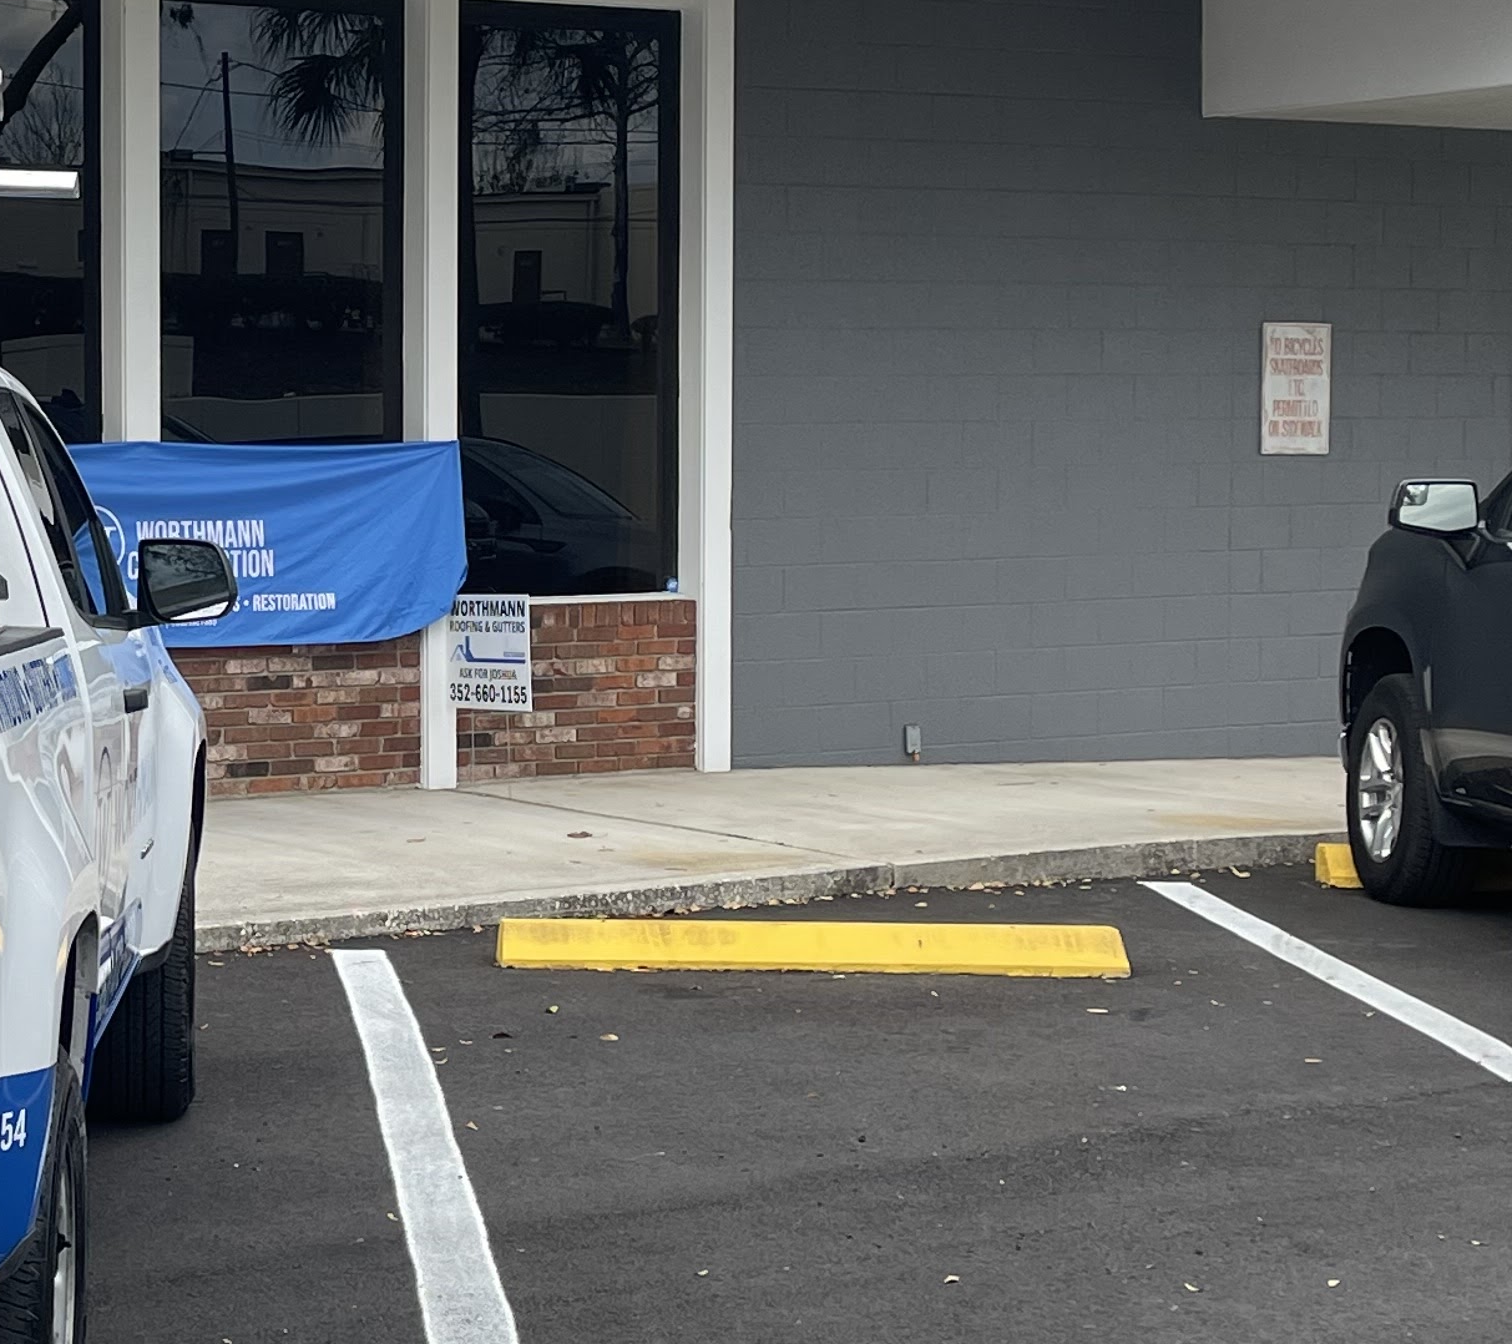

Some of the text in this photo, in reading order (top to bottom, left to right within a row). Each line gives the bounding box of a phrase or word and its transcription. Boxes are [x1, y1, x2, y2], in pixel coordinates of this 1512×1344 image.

[1284, 338, 1324, 355] BICYCLES
[252, 593, 336, 612] RESTORATION
[450, 600, 525, 617] WORTHMANN
[450, 621, 525, 633] ROOFING & GUTTERS
[459, 668, 472, 679] ASK
[474, 668, 488, 679] FOR
[450, 683, 527, 704] 352-660-1155
